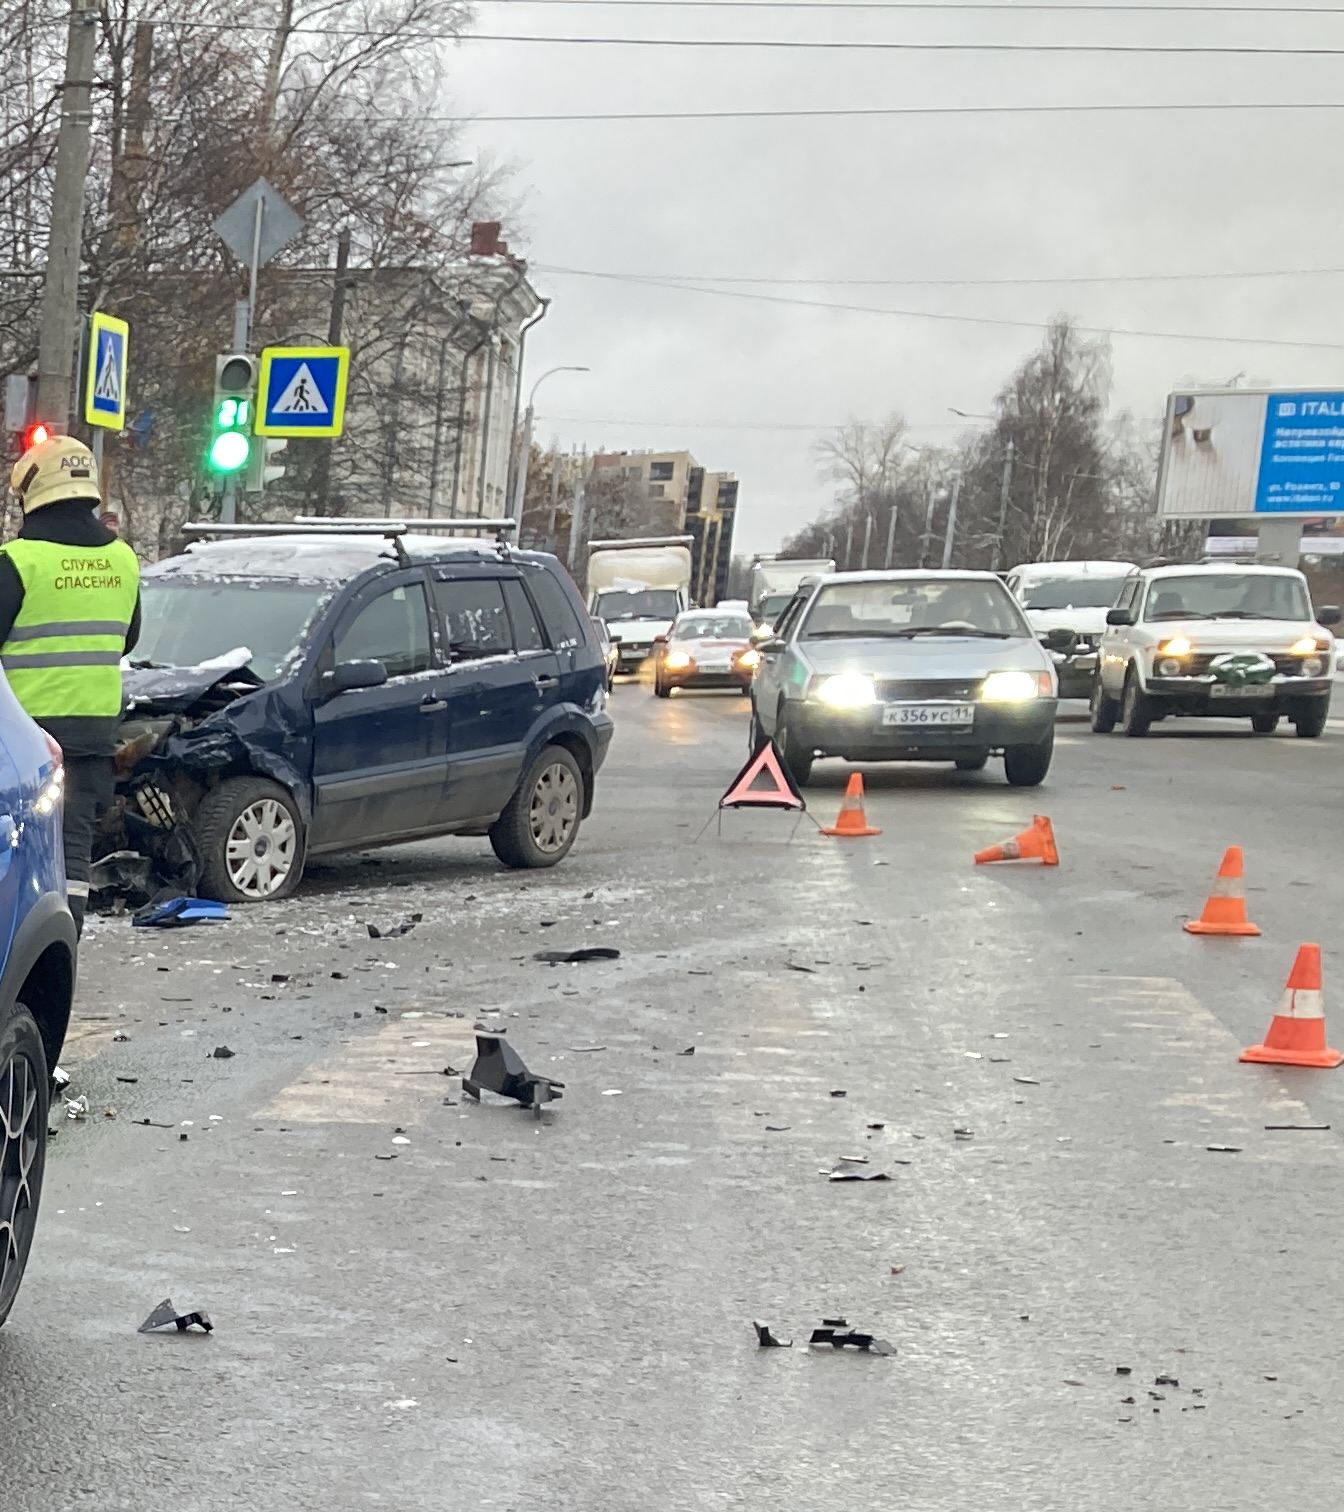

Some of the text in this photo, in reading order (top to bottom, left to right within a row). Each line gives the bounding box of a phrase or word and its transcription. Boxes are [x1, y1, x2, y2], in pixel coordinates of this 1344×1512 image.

[218, 399, 249, 428] 21
[1301, 401, 1344, 416] ITAL
[61, 557, 114, 572] СЛУЖБА
[54, 575, 122, 590] СПАСЕНИЯ
